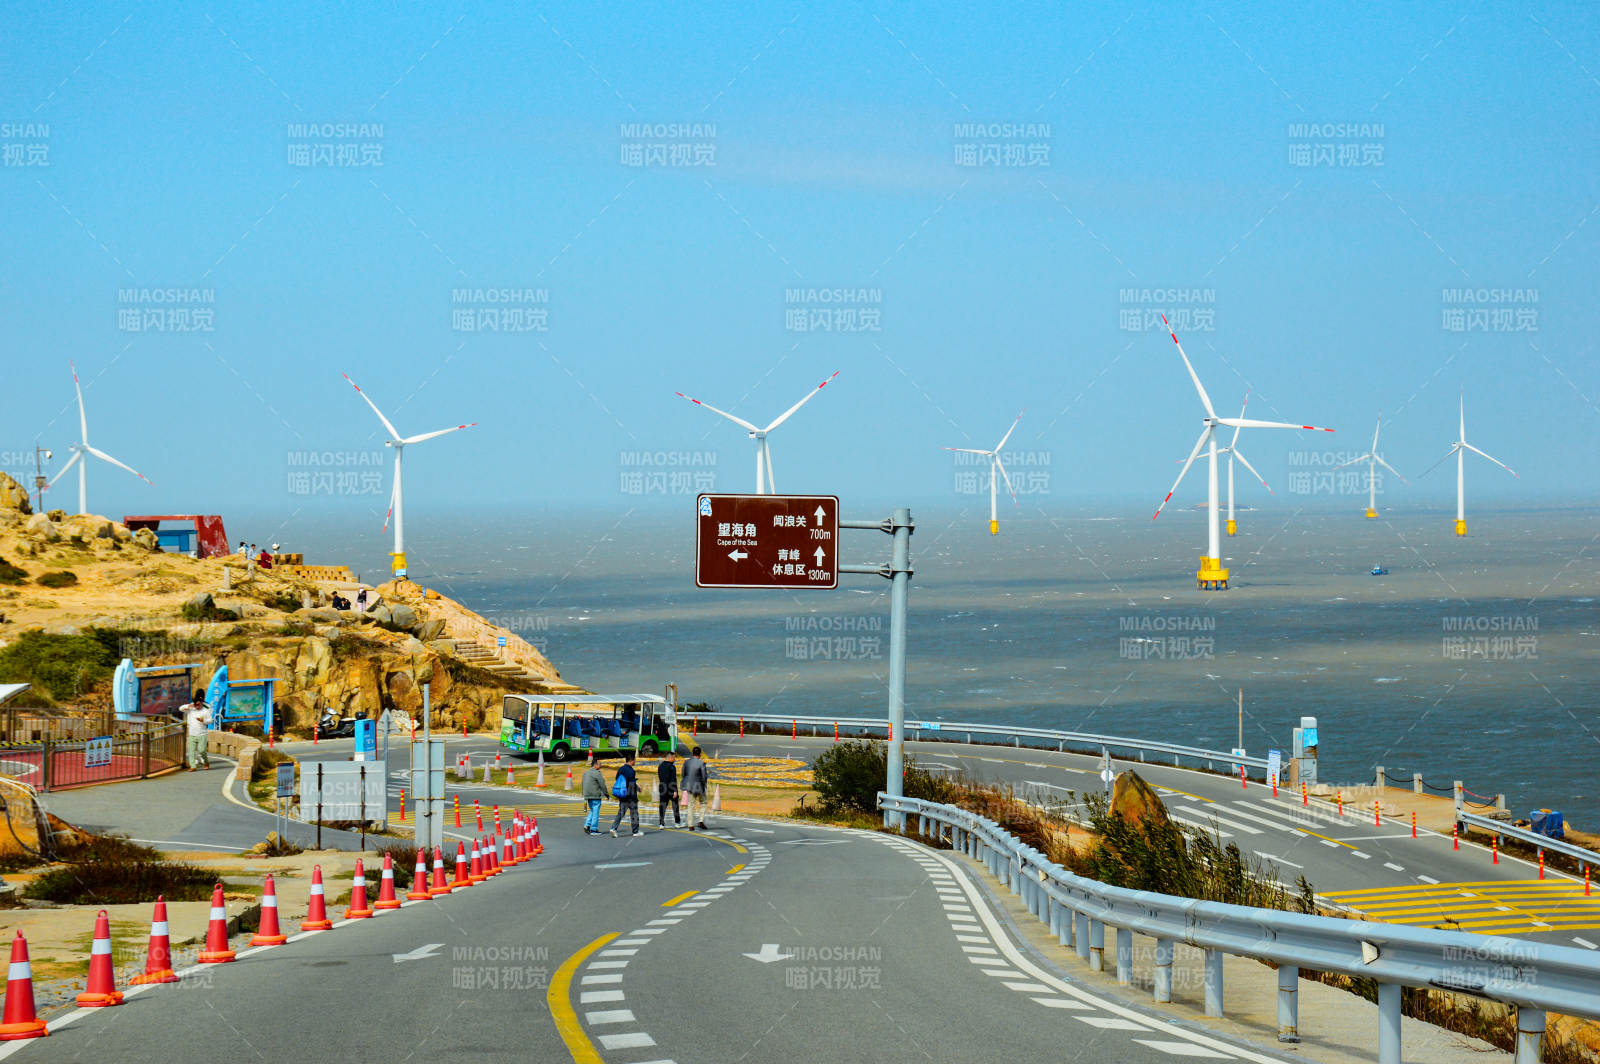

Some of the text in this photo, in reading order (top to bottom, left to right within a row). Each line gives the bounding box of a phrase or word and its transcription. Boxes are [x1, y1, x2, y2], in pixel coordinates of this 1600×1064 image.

[717, 522, 757, 537] 望海角
[809, 528, 831, 540] 700m
[717, 538, 731, 547] Cape
[738, 538, 746, 546] the
[747, 538, 758, 546] Sea
[777, 549, 800, 561] 青峰
[772, 563, 806, 576] 休息区
[807, 569, 831, 581] 1300m
